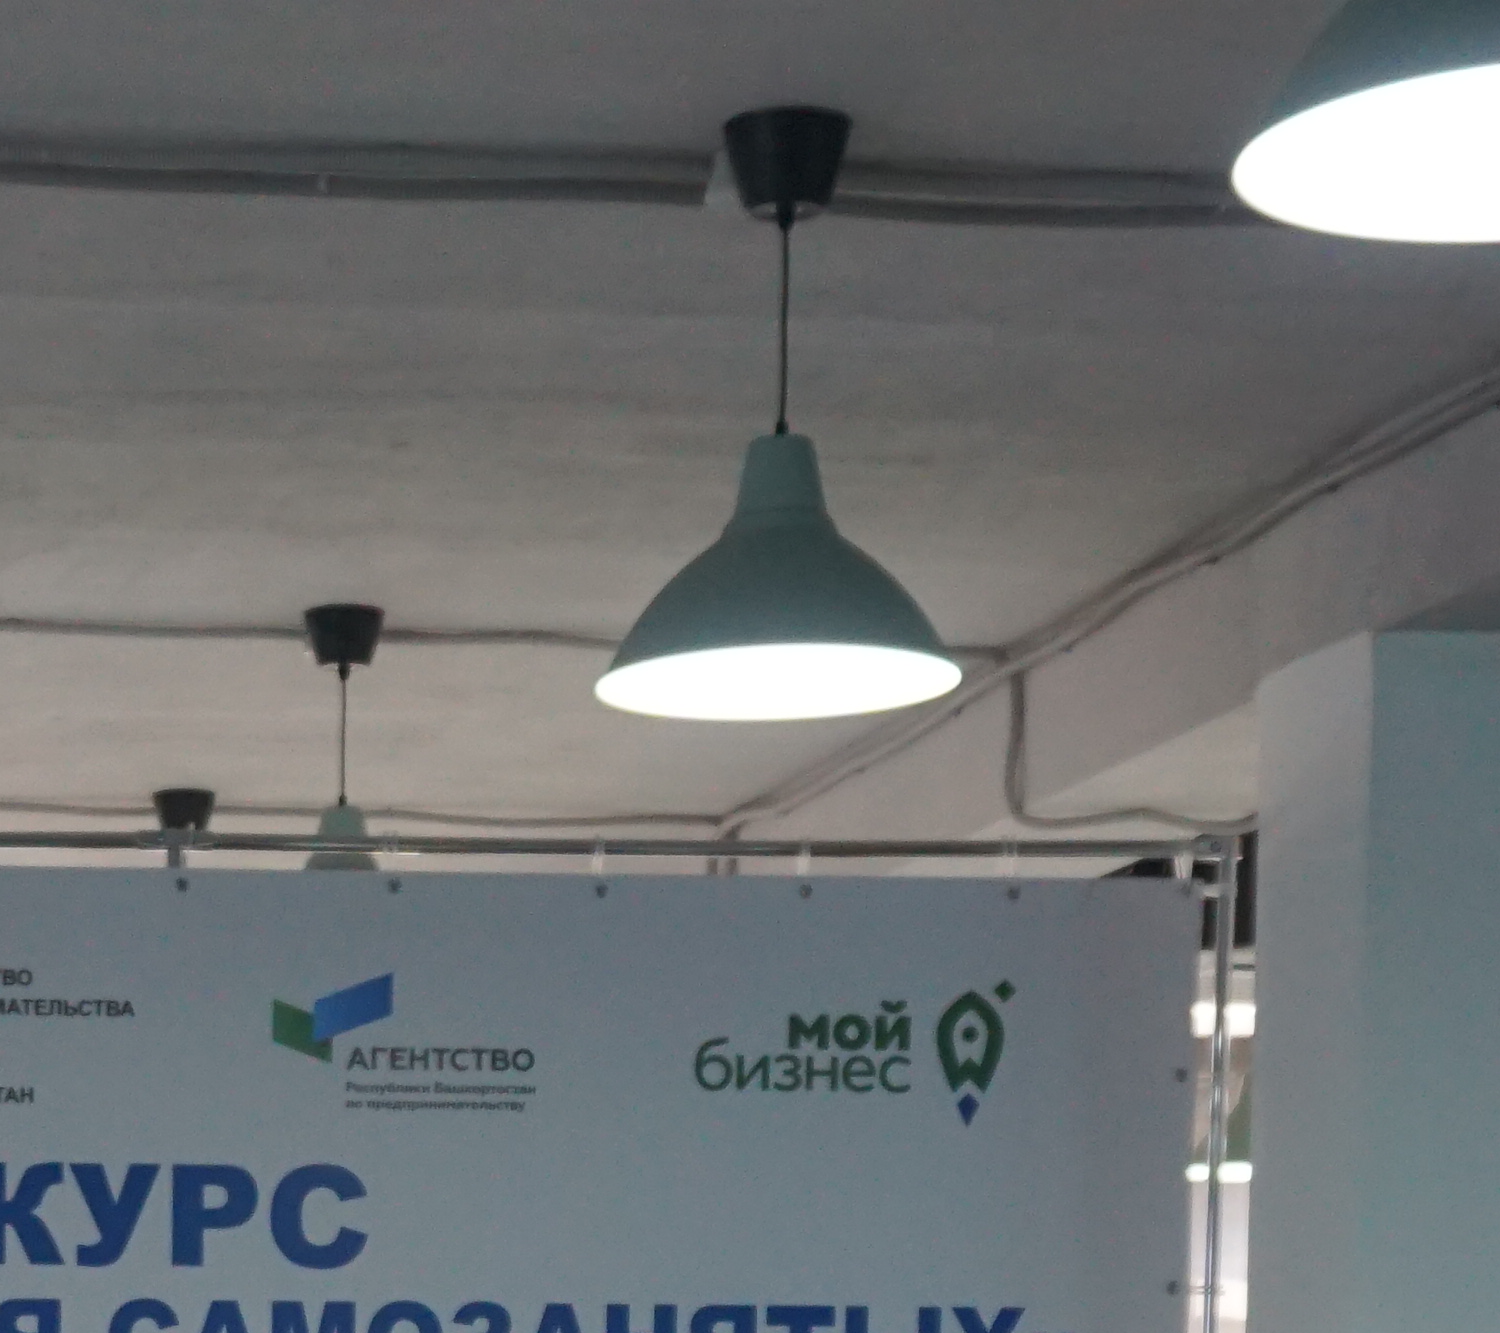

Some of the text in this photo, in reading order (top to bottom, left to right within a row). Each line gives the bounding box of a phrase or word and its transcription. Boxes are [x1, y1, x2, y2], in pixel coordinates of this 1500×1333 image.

[788, 999, 912, 1051] мой
[346, 1048, 536, 1072] АГЕНТСТВО
[694, 1036, 912, 1093] бизнес
